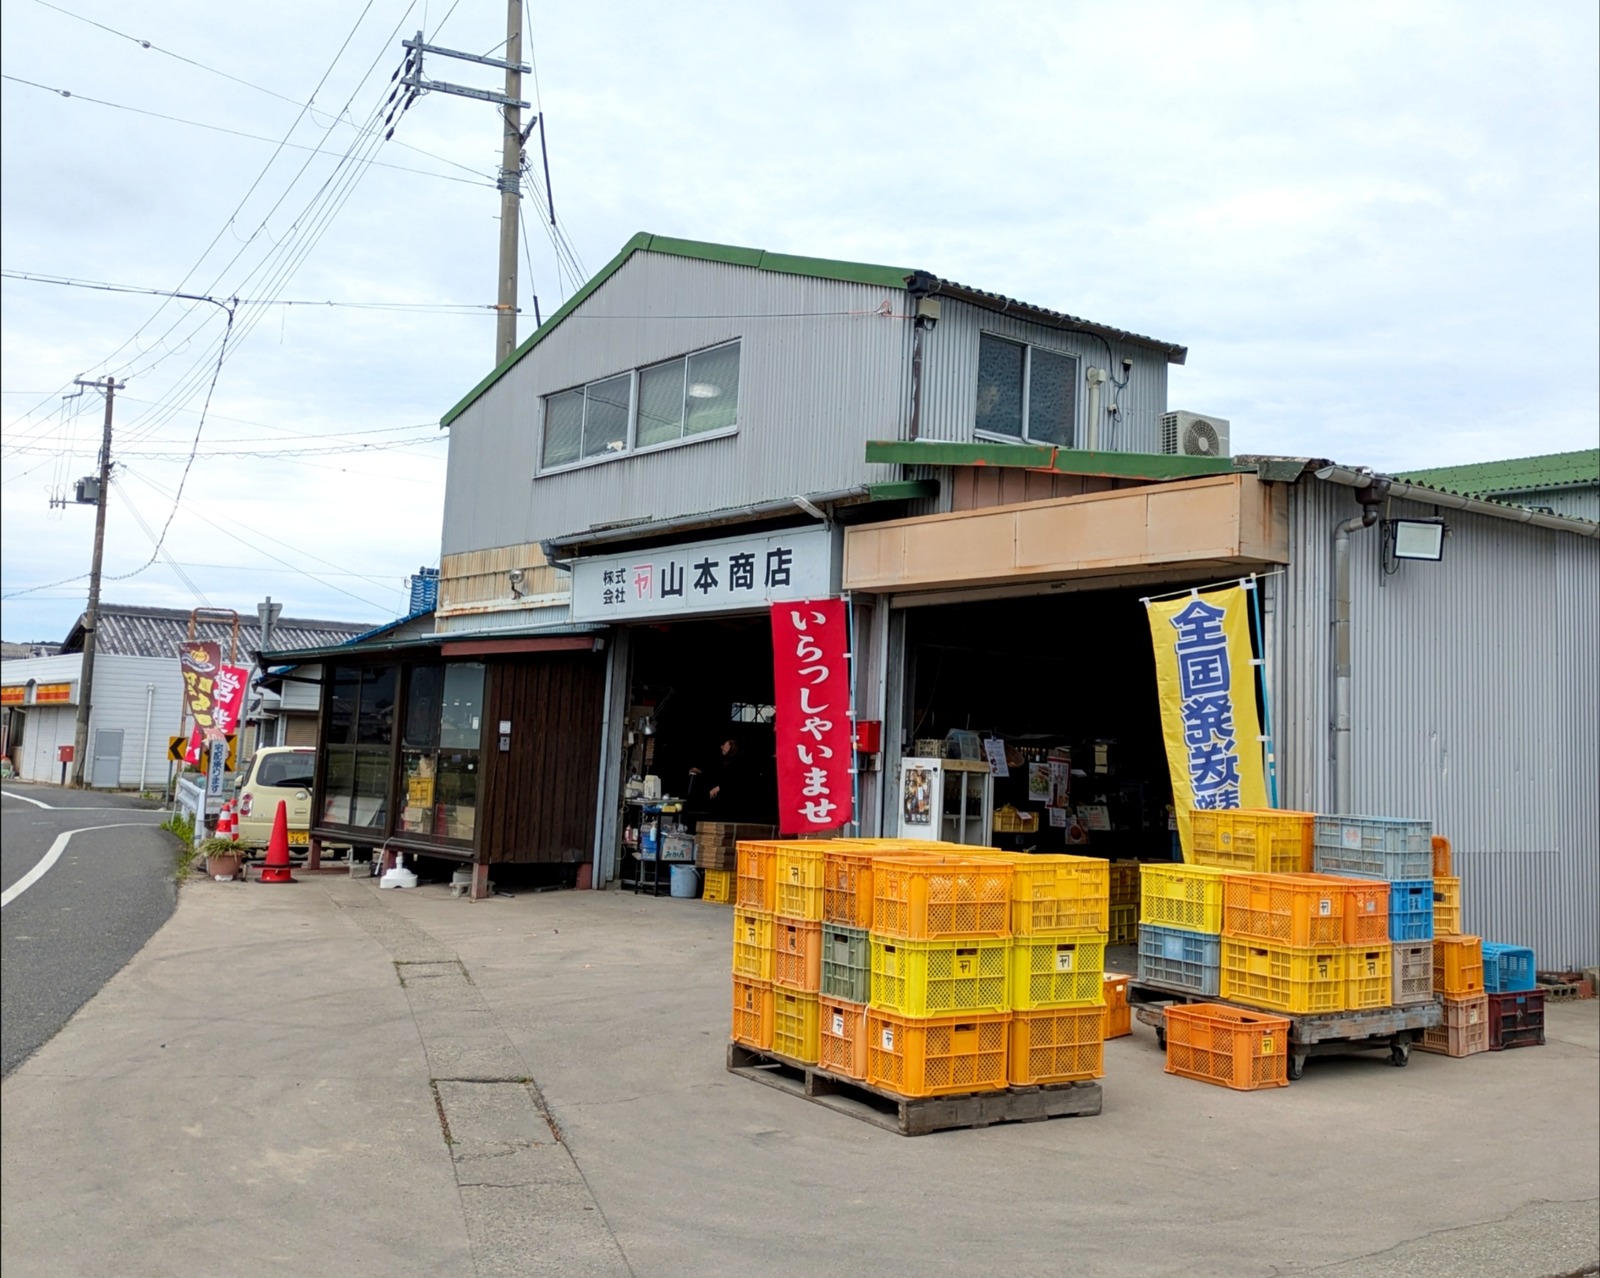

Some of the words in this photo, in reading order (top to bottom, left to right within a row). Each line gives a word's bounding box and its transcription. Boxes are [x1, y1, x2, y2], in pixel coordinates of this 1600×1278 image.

[603, 567, 627, 586] 株式
[660, 547, 793, 600] 山本商店
[603, 587, 627, 605] 会社
